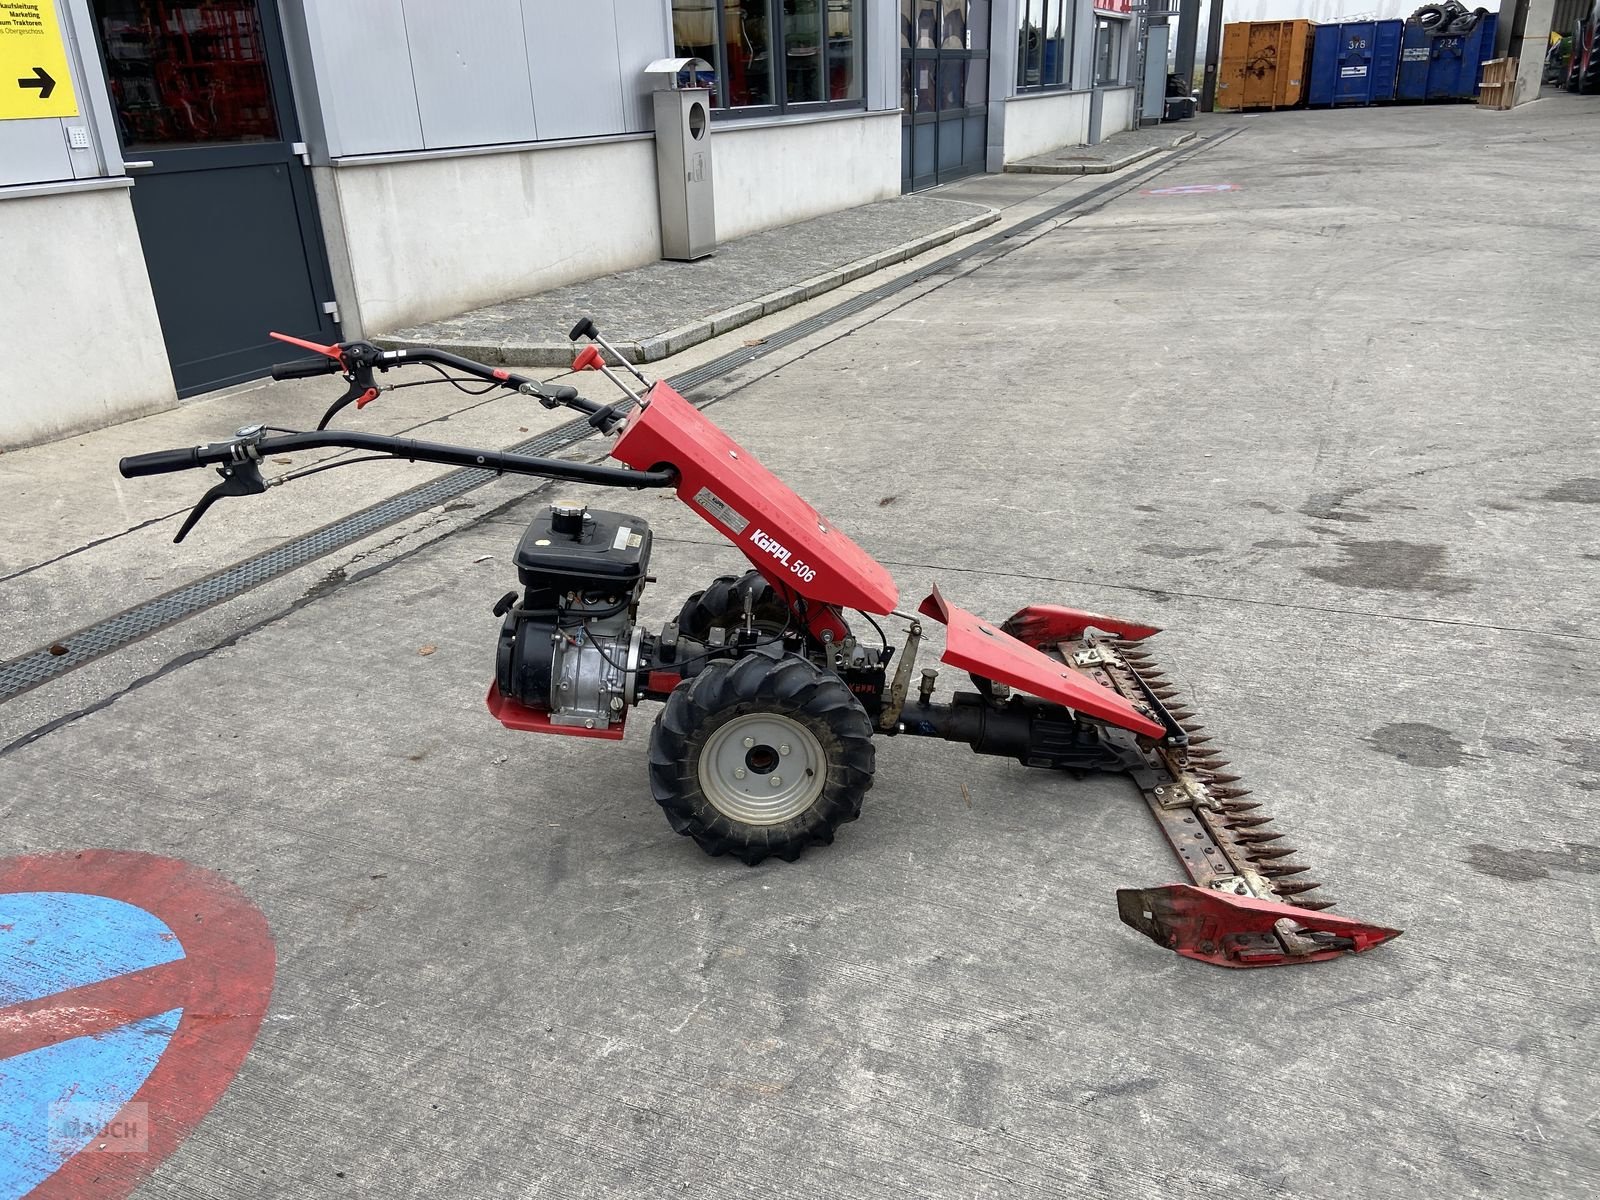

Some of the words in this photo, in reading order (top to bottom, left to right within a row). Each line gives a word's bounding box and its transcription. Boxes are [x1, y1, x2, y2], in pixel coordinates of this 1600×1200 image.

[9, 11, 40, 19] Marketing
[5, 27, 44, 35] Obergeschoss
[1348, 40, 1366, 49] 378
[790, 559, 817, 583] 506
